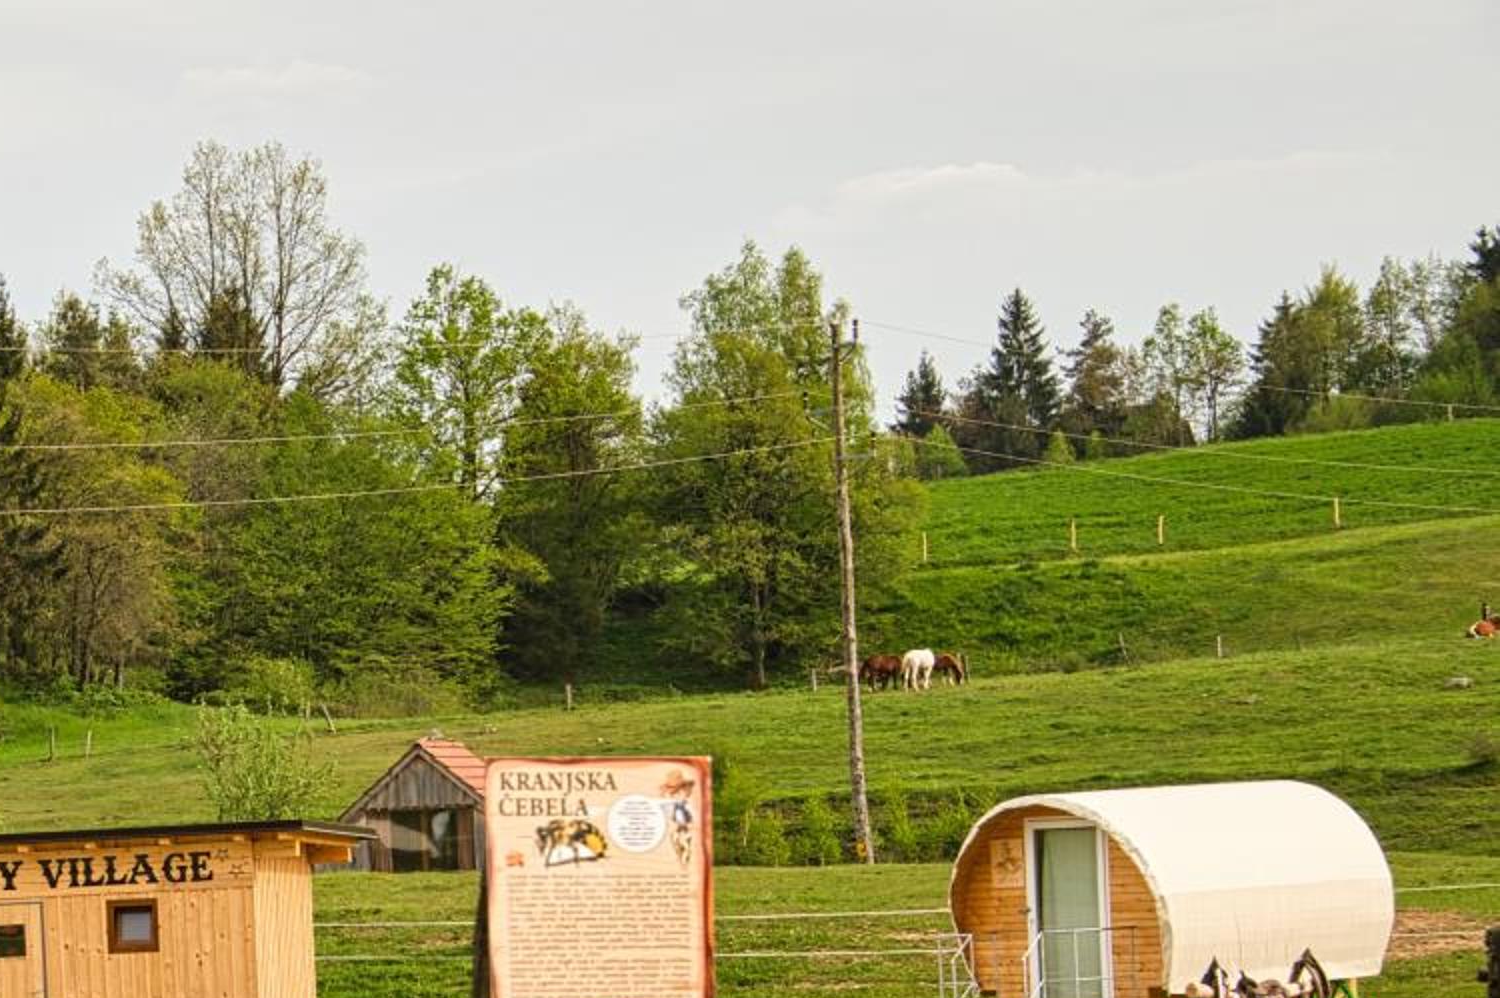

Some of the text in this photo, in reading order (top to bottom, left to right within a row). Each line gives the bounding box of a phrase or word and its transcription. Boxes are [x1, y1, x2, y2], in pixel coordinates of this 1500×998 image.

[500, 771, 618, 796] KRANJSKA
[498, 792, 588, 817] ČEBELA
[37, 851, 214, 889] VILLAGE
